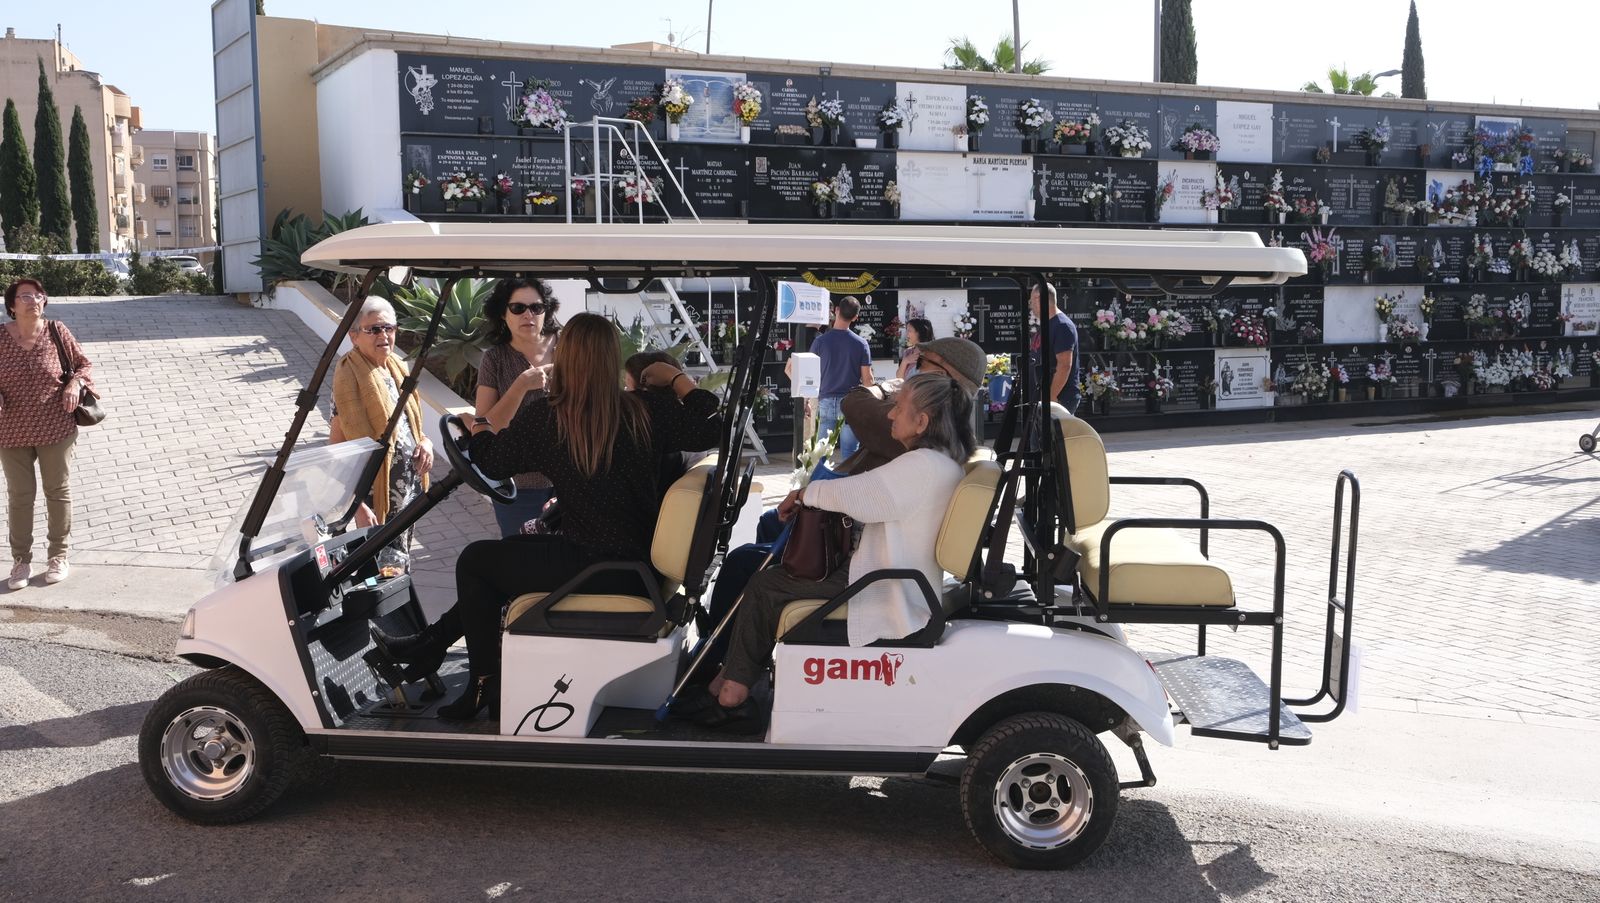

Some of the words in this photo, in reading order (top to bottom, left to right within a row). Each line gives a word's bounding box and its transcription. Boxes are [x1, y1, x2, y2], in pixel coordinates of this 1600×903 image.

[449, 66, 475, 74] MANUEL
[532, 156, 550, 164] Torres
[788, 161, 801, 169] JUAN
[770, 168, 790, 176] PACHÓN
[791, 169, 819, 177] BARRAGÁN
[1066, 172, 1088, 180] ANTONIO
